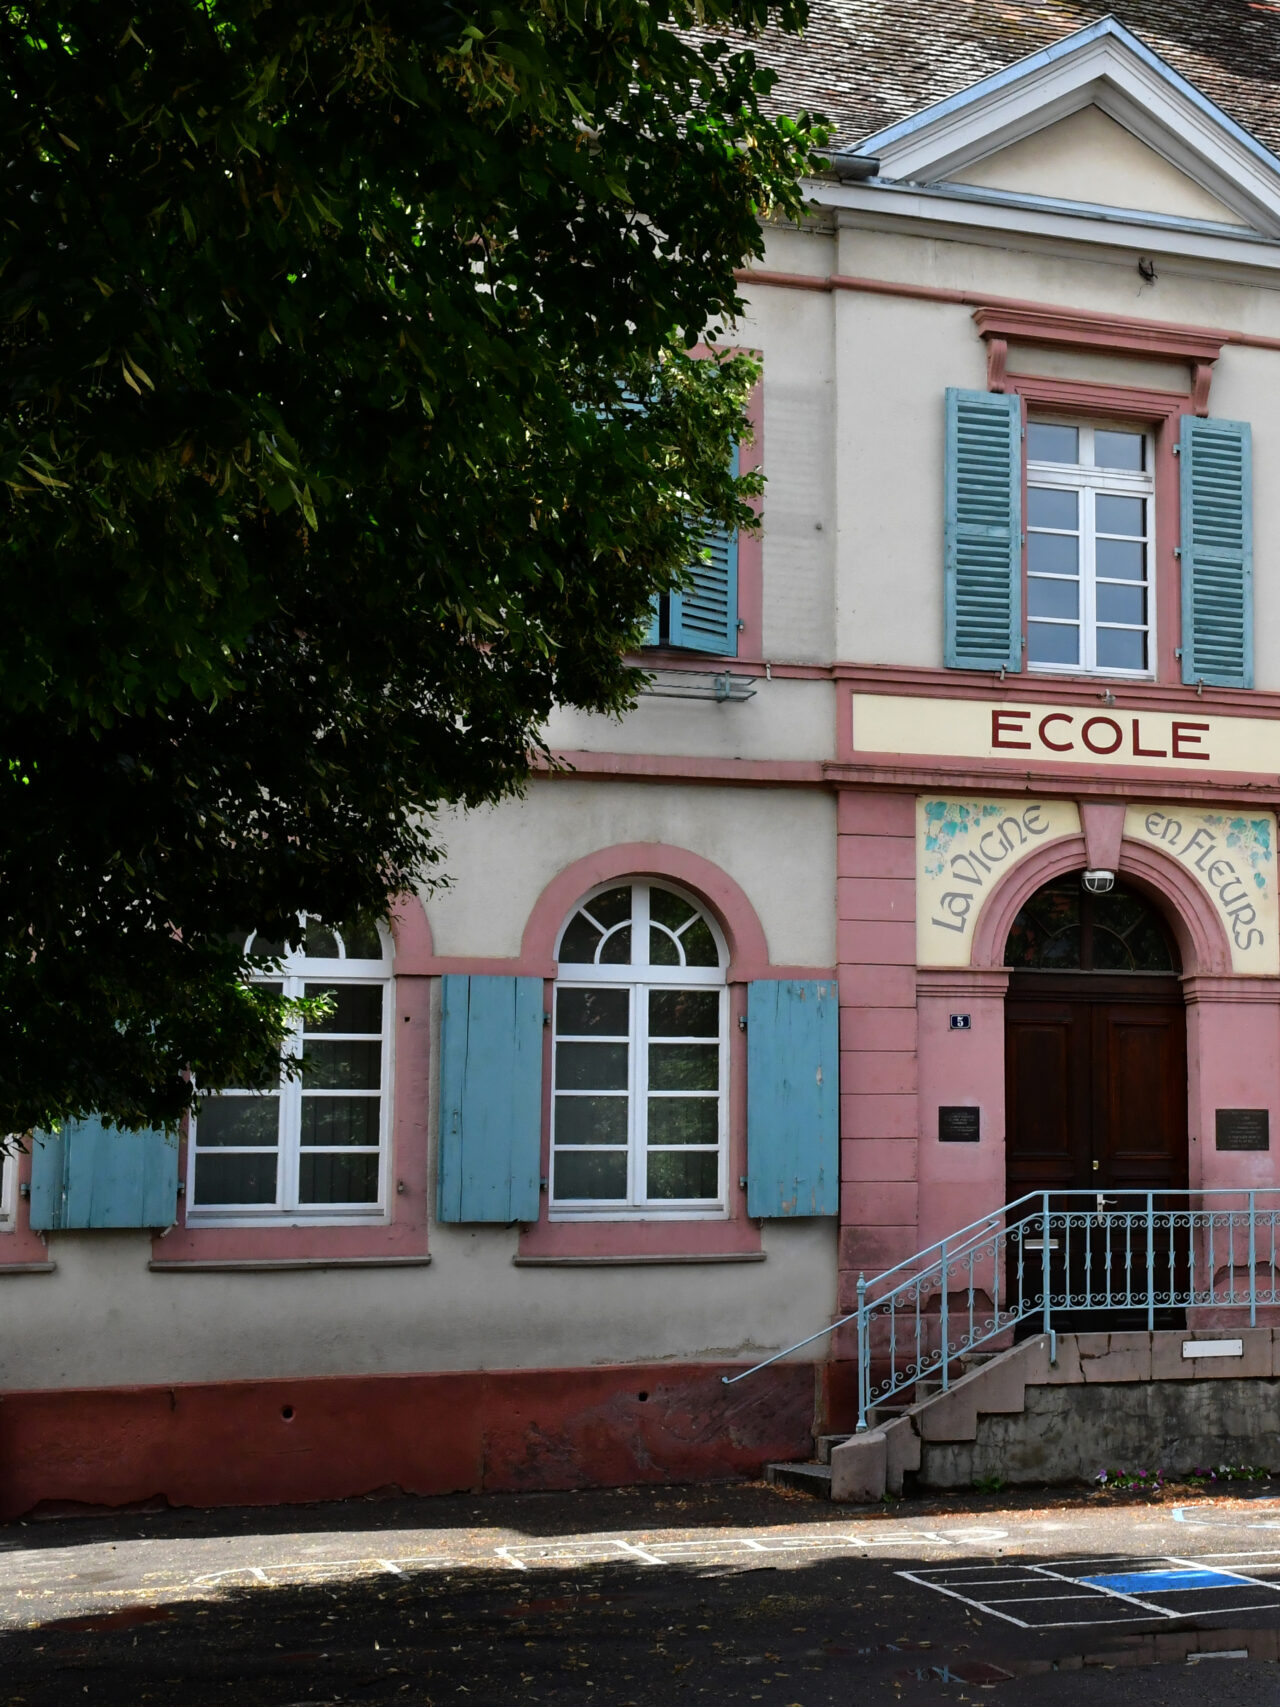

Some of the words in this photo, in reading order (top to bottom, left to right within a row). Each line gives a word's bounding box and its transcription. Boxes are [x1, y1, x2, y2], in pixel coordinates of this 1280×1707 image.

[991, 709, 1210, 761] ECOLE
[950, 805, 1049, 886] VIGNE
[1176, 828, 1264, 951] FLEURS
[956, 1016, 964, 1027] 5
